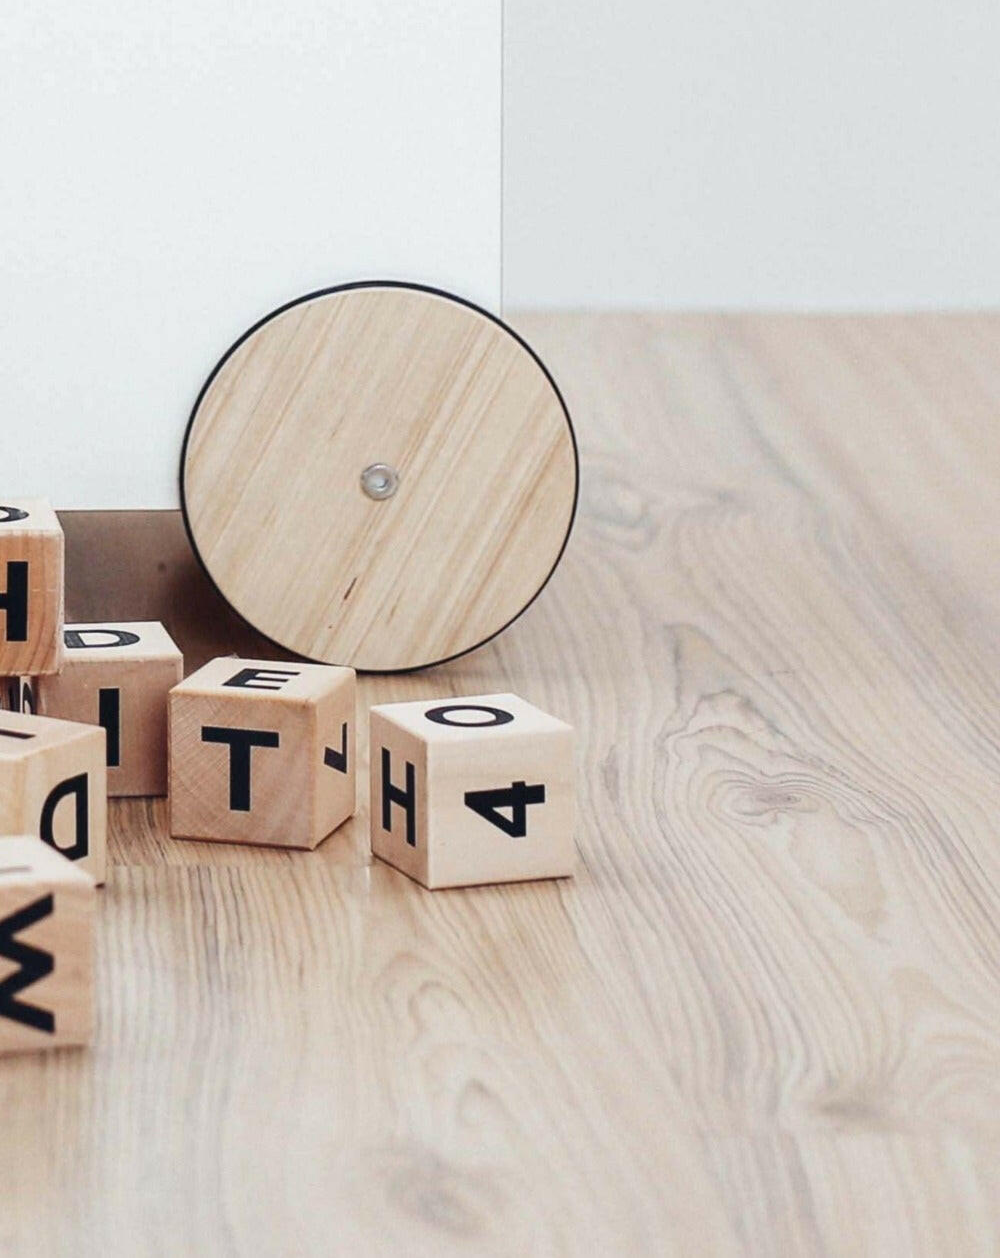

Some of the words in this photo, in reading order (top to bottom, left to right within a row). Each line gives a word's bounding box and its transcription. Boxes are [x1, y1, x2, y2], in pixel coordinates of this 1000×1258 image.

[64, 629, 141, 649] D
[222, 668, 300, 691] E
[424, 705, 514, 728] O
[201, 726, 280, 812] T
[381, 746, 416, 848] H
[39, 772, 89, 861] D
[464, 781, 545, 838] 4
